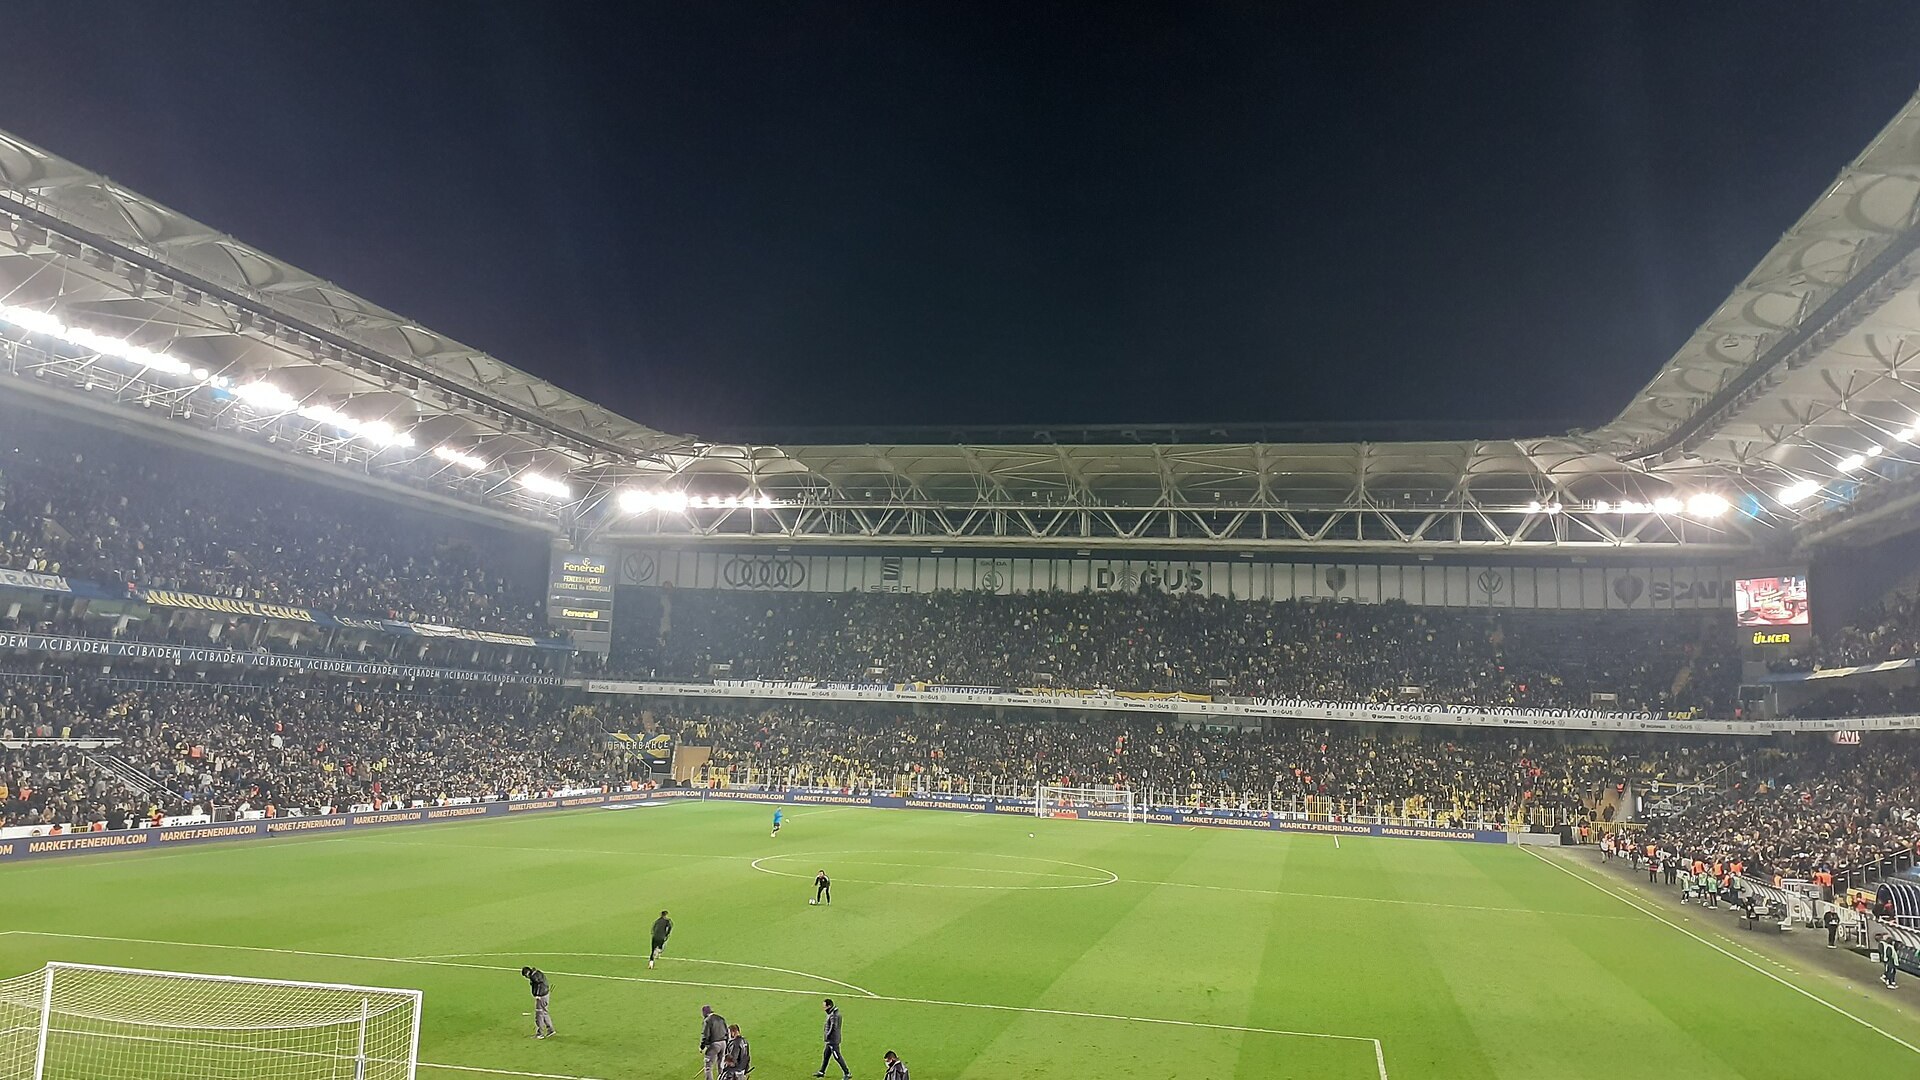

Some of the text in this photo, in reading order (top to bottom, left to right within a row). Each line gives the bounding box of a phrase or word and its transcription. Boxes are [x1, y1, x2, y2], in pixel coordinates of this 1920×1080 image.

[564, 562, 605, 574] Fenercell
[1753, 633, 1790, 644] ÜLKER
[39, 638, 109, 655] ACIBADEM
[118, 645, 181, 660] ACIBADEM
[189, 651, 244, 664] ACIBADEM
[252, 656, 301, 669] ACIBADEM
[307, 661, 352, 673] ACIBADEM
[357, 664, 398, 676] ACIBADEM
[402, 667, 440, 680] ACIBADEM
[444, 671, 478, 682] ACIBADEM
[482, 674, 516, 685] ACIBADEM
[29, 834, 147, 853] MARKET.FENERIUM.COM
[160, 825, 257, 842] MARKET.FENERIUM.COM
[267, 818, 346, 832] MARKET.FENERIUM.COM
[353, 812, 421, 825] MARKET.FENERIUM.COM
[428, 806, 487, 819] MARKET.FENERIUM.COM
[709, 789, 785, 801] MARKET.FENERIUM.COM
[794, 794, 871, 805] MARKET.FENERIUM.COM
[905, 800, 986, 811] MARKET.FENERIUM.COM
[1182, 815, 1271, 827] MARKET.FENERIUM.COM
[1280, 821, 1371, 833] MARKET.FENERIUM.COM
[1381, 827, 1475, 839] MARKET.FENERIUM.COM
